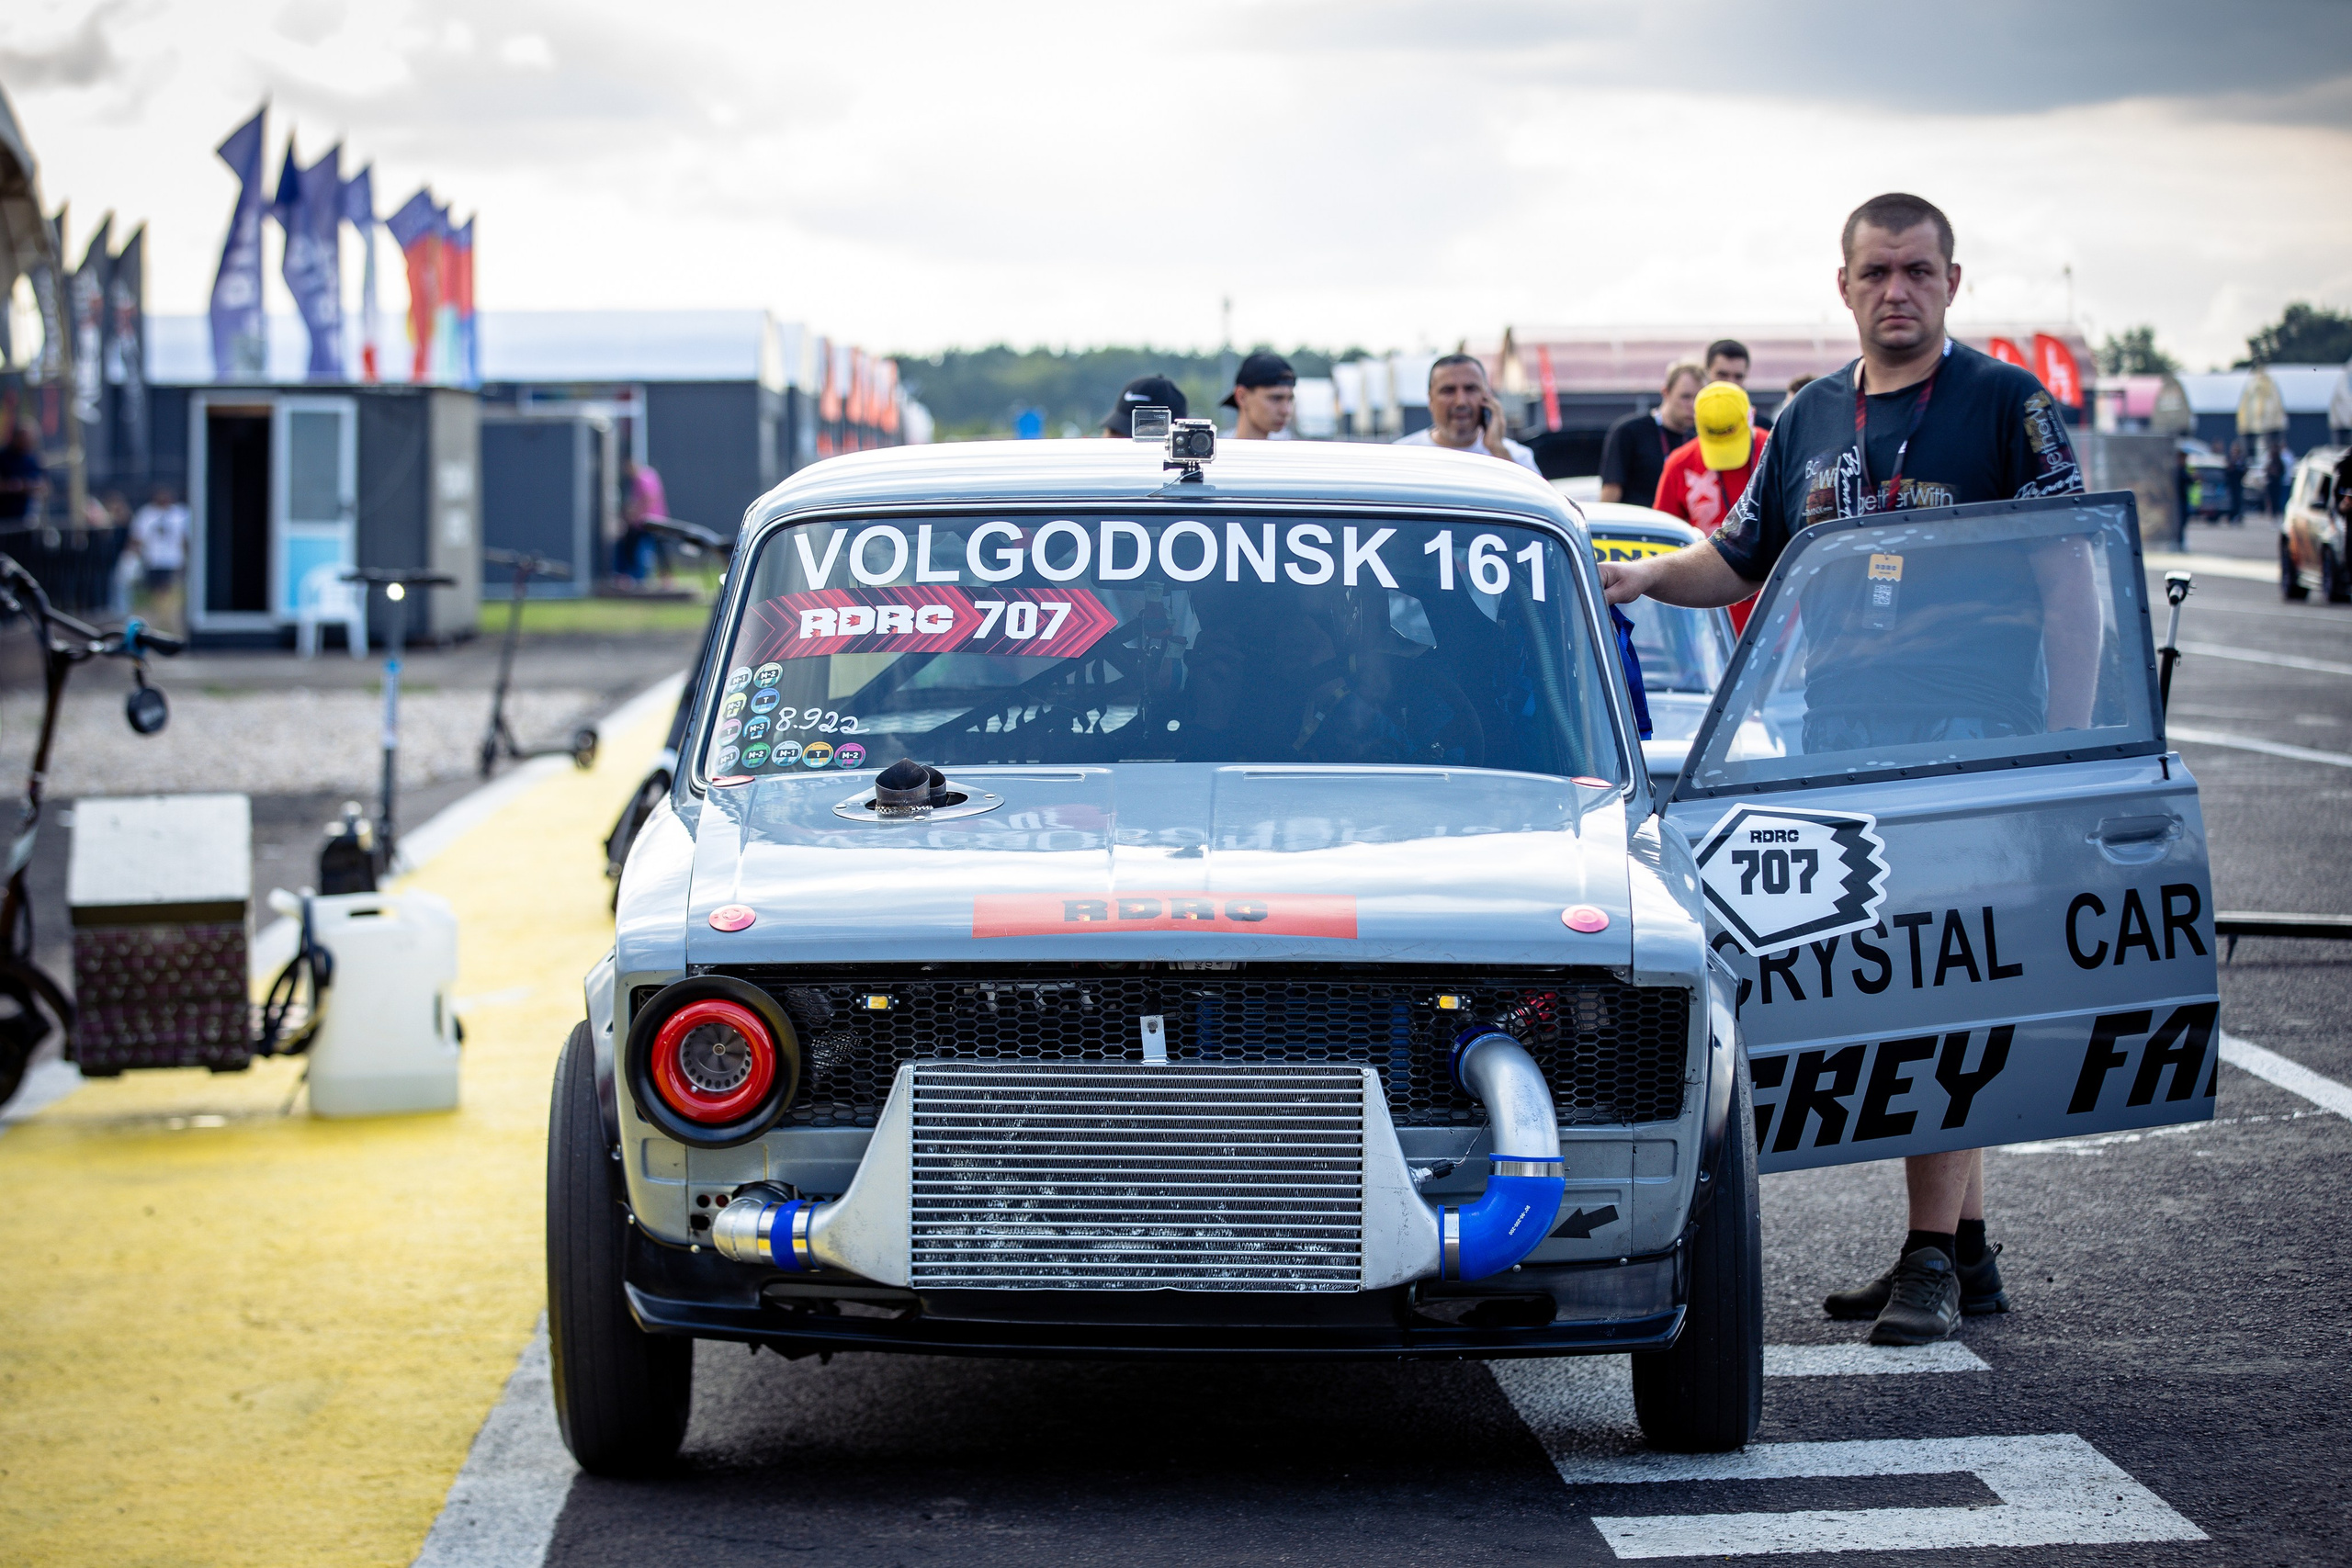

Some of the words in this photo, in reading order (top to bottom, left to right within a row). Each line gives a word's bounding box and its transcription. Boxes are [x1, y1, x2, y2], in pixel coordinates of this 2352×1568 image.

[794, 520, 1399, 591] VOLGODONSK
[1424, 530, 1545, 603] 161
[799, 605, 955, 639] RDRC
[972, 601, 1072, 640] 707
[732, 675, 746, 684] M-1
[761, 671, 776, 679] M-2
[750, 723, 764, 732] M-3
[775, 706, 870, 735] 8.922
[748, 750, 763, 759] M-2
[1750, 829, 1799, 843] RDRC
[1731, 848, 1819, 895] 707
[1063, 897, 1269, 921] RDRC
[2065, 883, 2208, 970] CAR
[2067, 1000, 2220, 1115] FA
